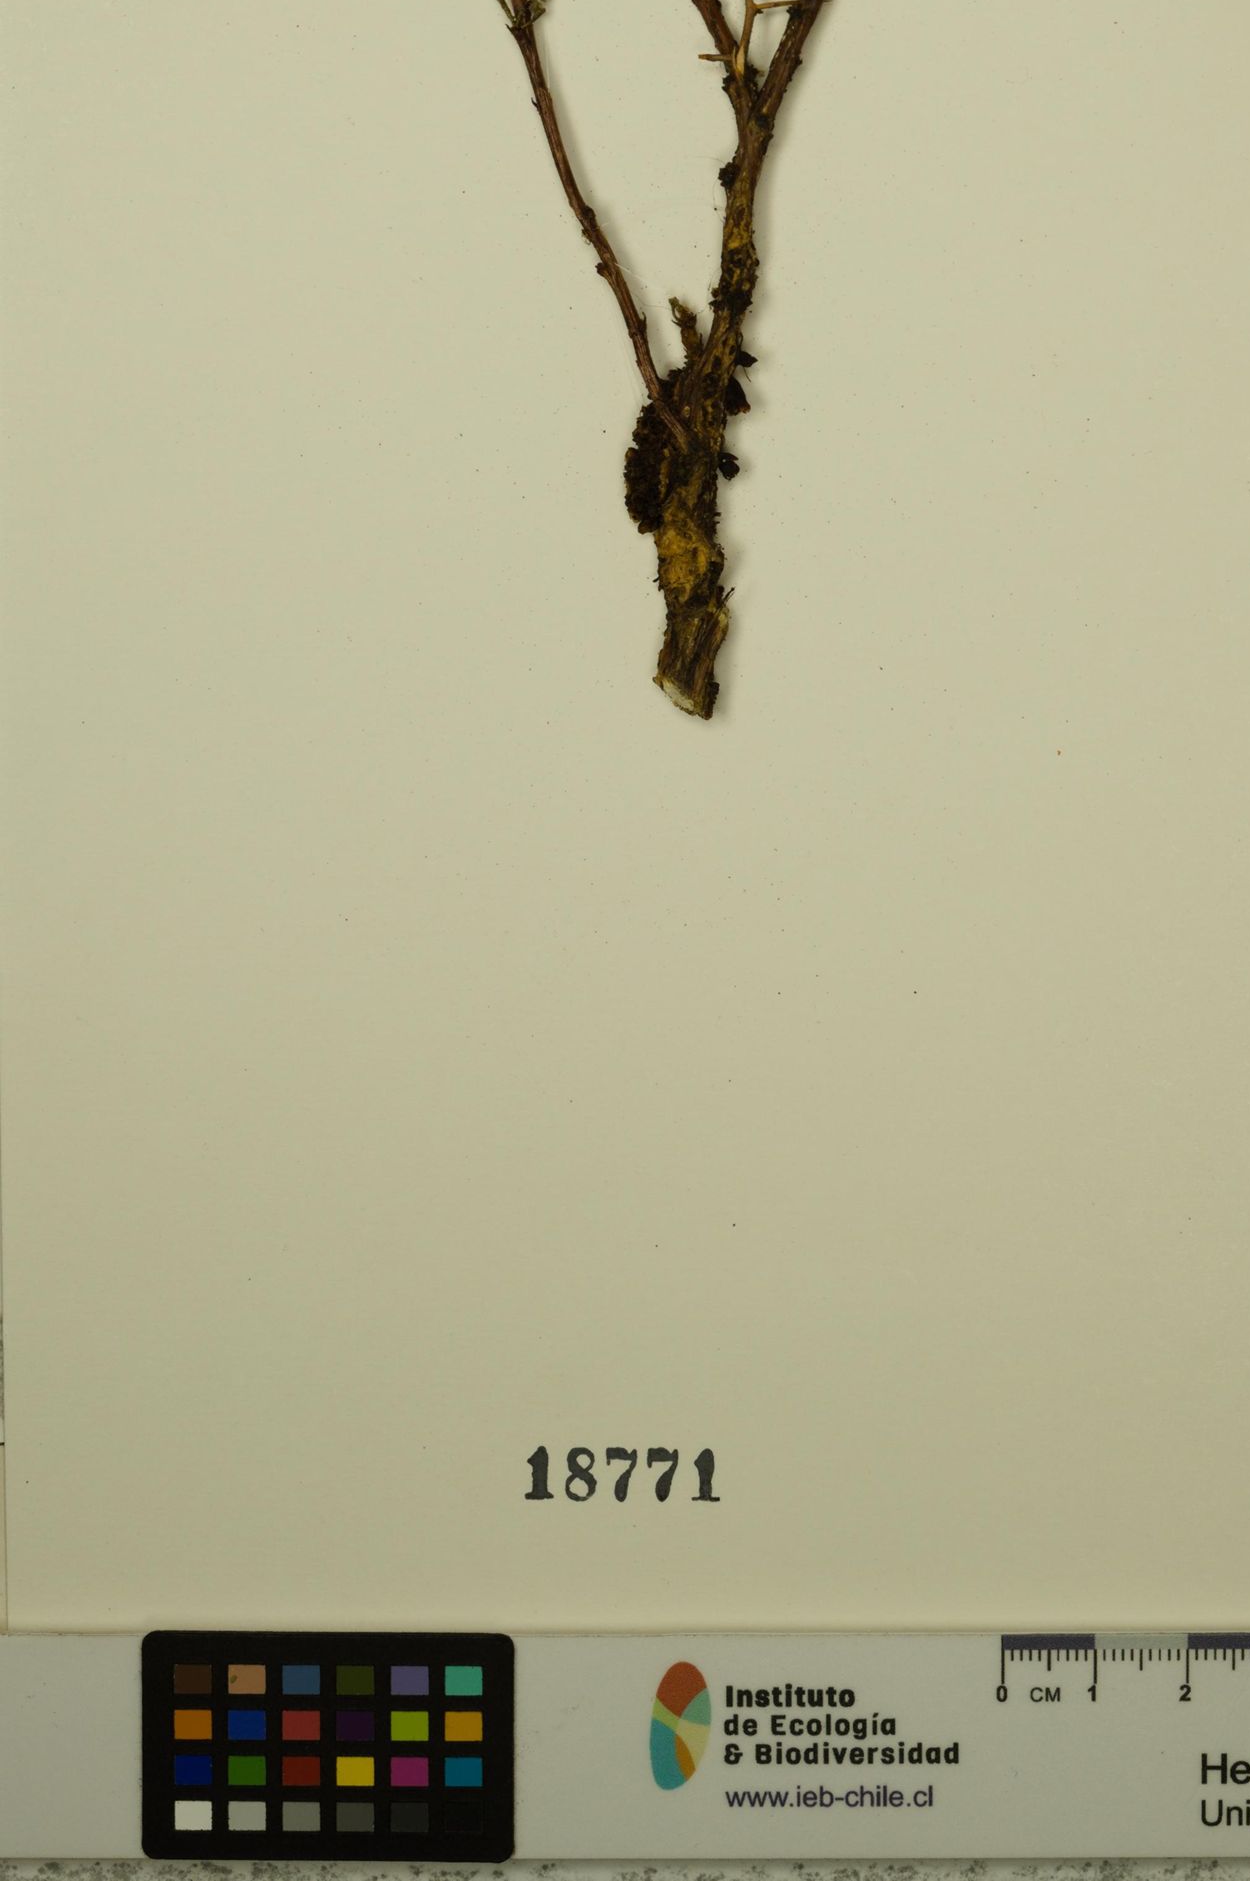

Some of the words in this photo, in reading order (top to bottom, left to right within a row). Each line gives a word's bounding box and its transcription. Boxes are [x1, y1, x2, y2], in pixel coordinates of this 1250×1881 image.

[525, 1446, 720, 1502] 18771
[726, 1684, 855, 1707] Instituto
[996, 1684, 1008, 1702] 0
[1029, 1686, 1061, 1702] CM
[1087, 1684, 1097, 1701] 1
[1179, 1684, 1191, 1701] 2
[724, 1714, 757, 1736] de
[771, 1713, 896, 1740] Ecología
[724, 1743, 743, 1765] &
[755, 1742, 959, 1765] Biodiversidad
[726, 1785, 933, 1807] www.ieb-chile.cl
